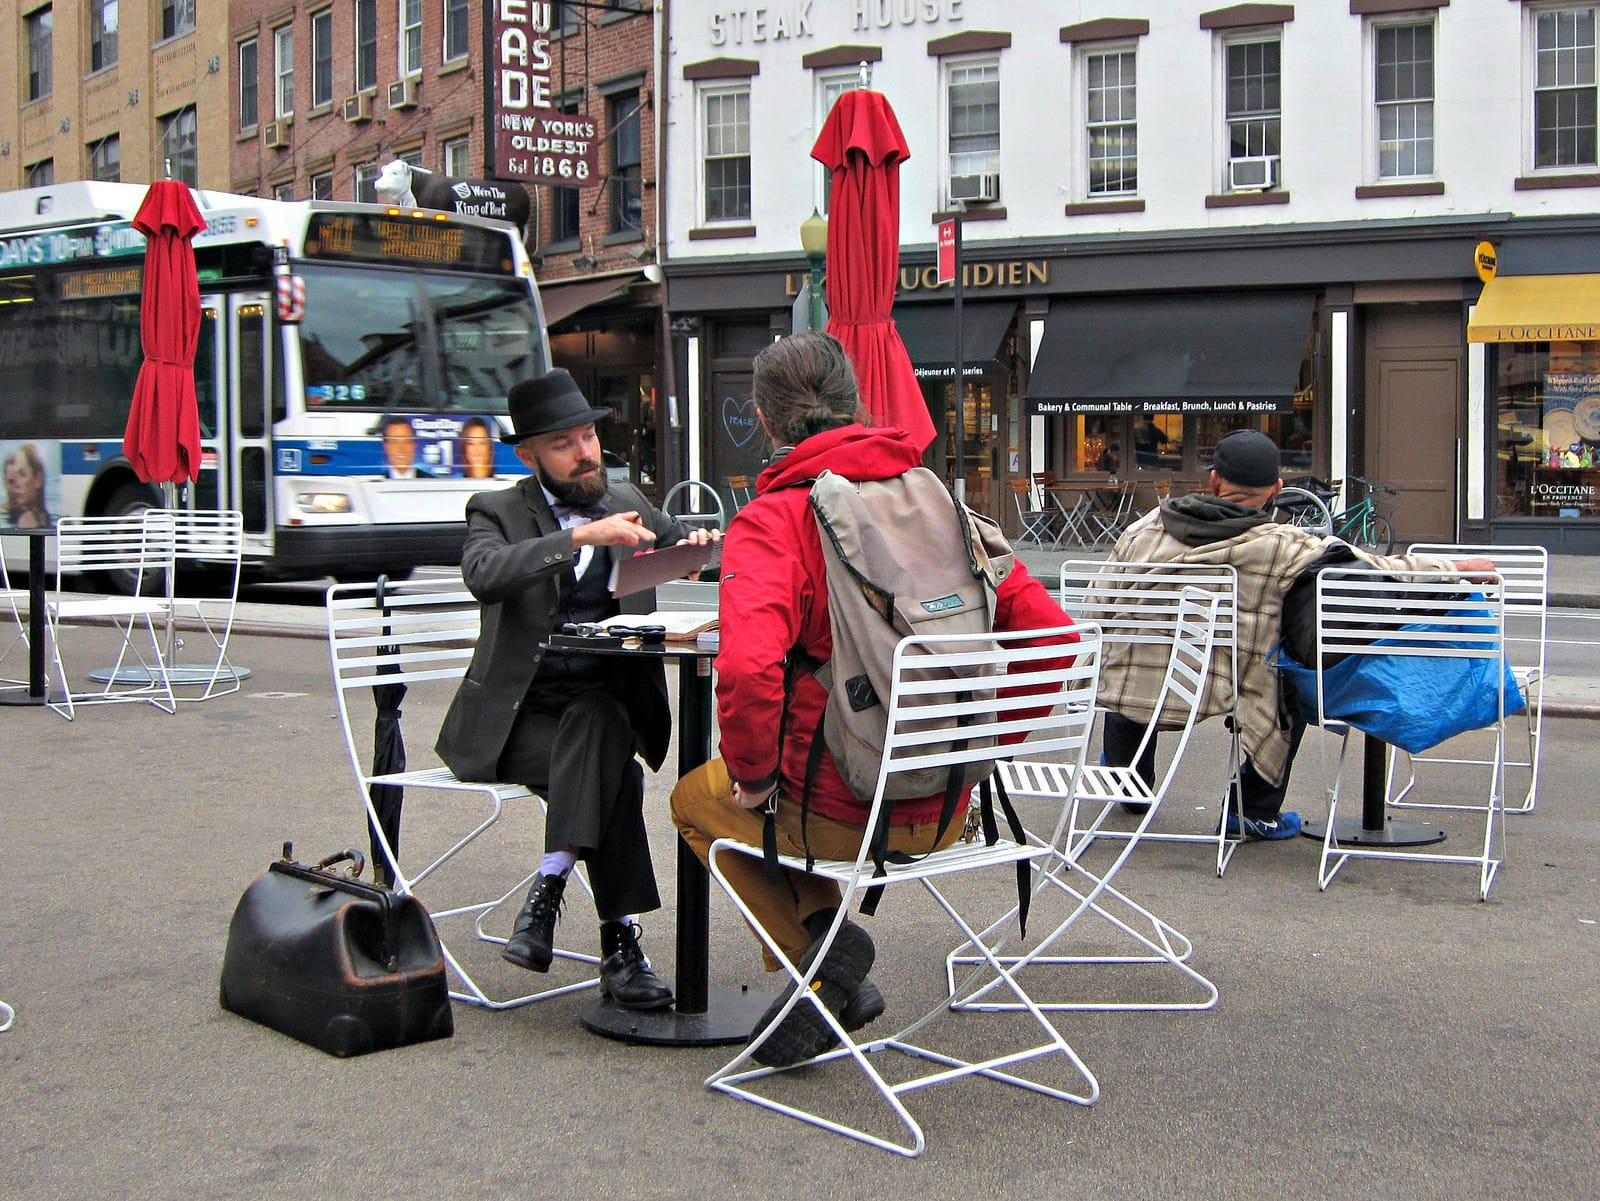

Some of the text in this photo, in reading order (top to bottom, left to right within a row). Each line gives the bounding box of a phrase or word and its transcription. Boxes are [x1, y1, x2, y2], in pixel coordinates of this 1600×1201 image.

[709, 0, 963, 46] STEAK HOUSE
[501, 113, 594, 138] NEW YORK'S
[511, 135, 590, 155] OLDEST
[533, 156, 589, 179] 1868
[490, 187, 506, 199] The
[455, 200, 507, 218] King of Beef
[1497, 326, 1597, 341] L'OCCITANE
[943, 367, 950, 376] et
[1038, 401, 1277, 413] Bakery & Communal Table Breakfast, Brunch, Lunch & Pastries
[1530, 483, 1596, 495] L'OCCITANE
